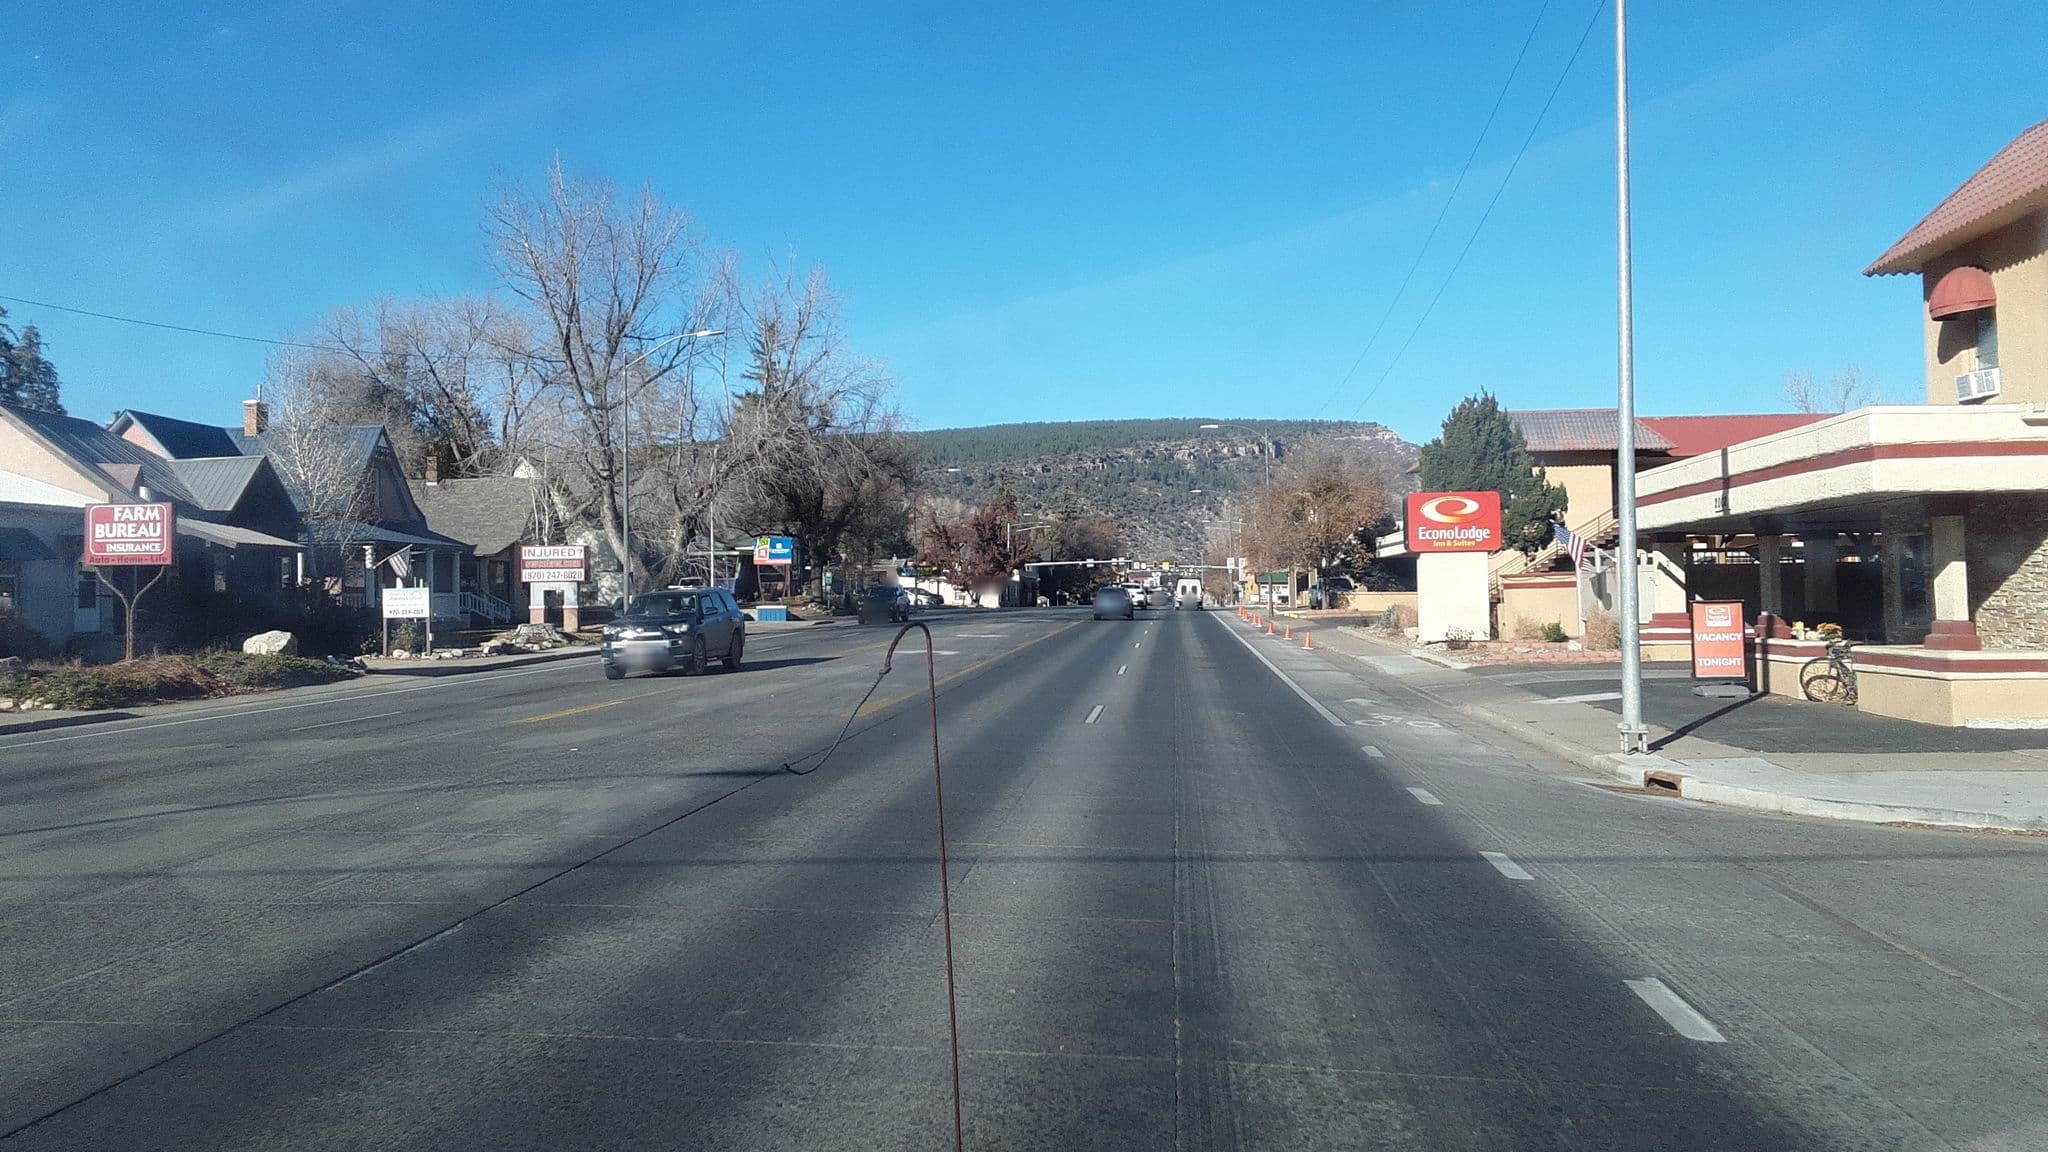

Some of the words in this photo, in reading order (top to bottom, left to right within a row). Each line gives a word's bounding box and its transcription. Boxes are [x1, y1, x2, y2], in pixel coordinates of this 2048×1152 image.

[113, 507, 160, 521] FARM
[95, 523, 161, 538] BUREAU
[1418, 526, 1491, 542] EconoLodge
[106, 543, 161, 553] INSURANCE
[523, 548, 583, 558] INJURED?
[89, 556, 110, 564] Auto
[150, 555, 168, 563] Life
[1695, 632, 1743, 641] VACANCY
[1697, 657, 1743, 666] TONIGHT
